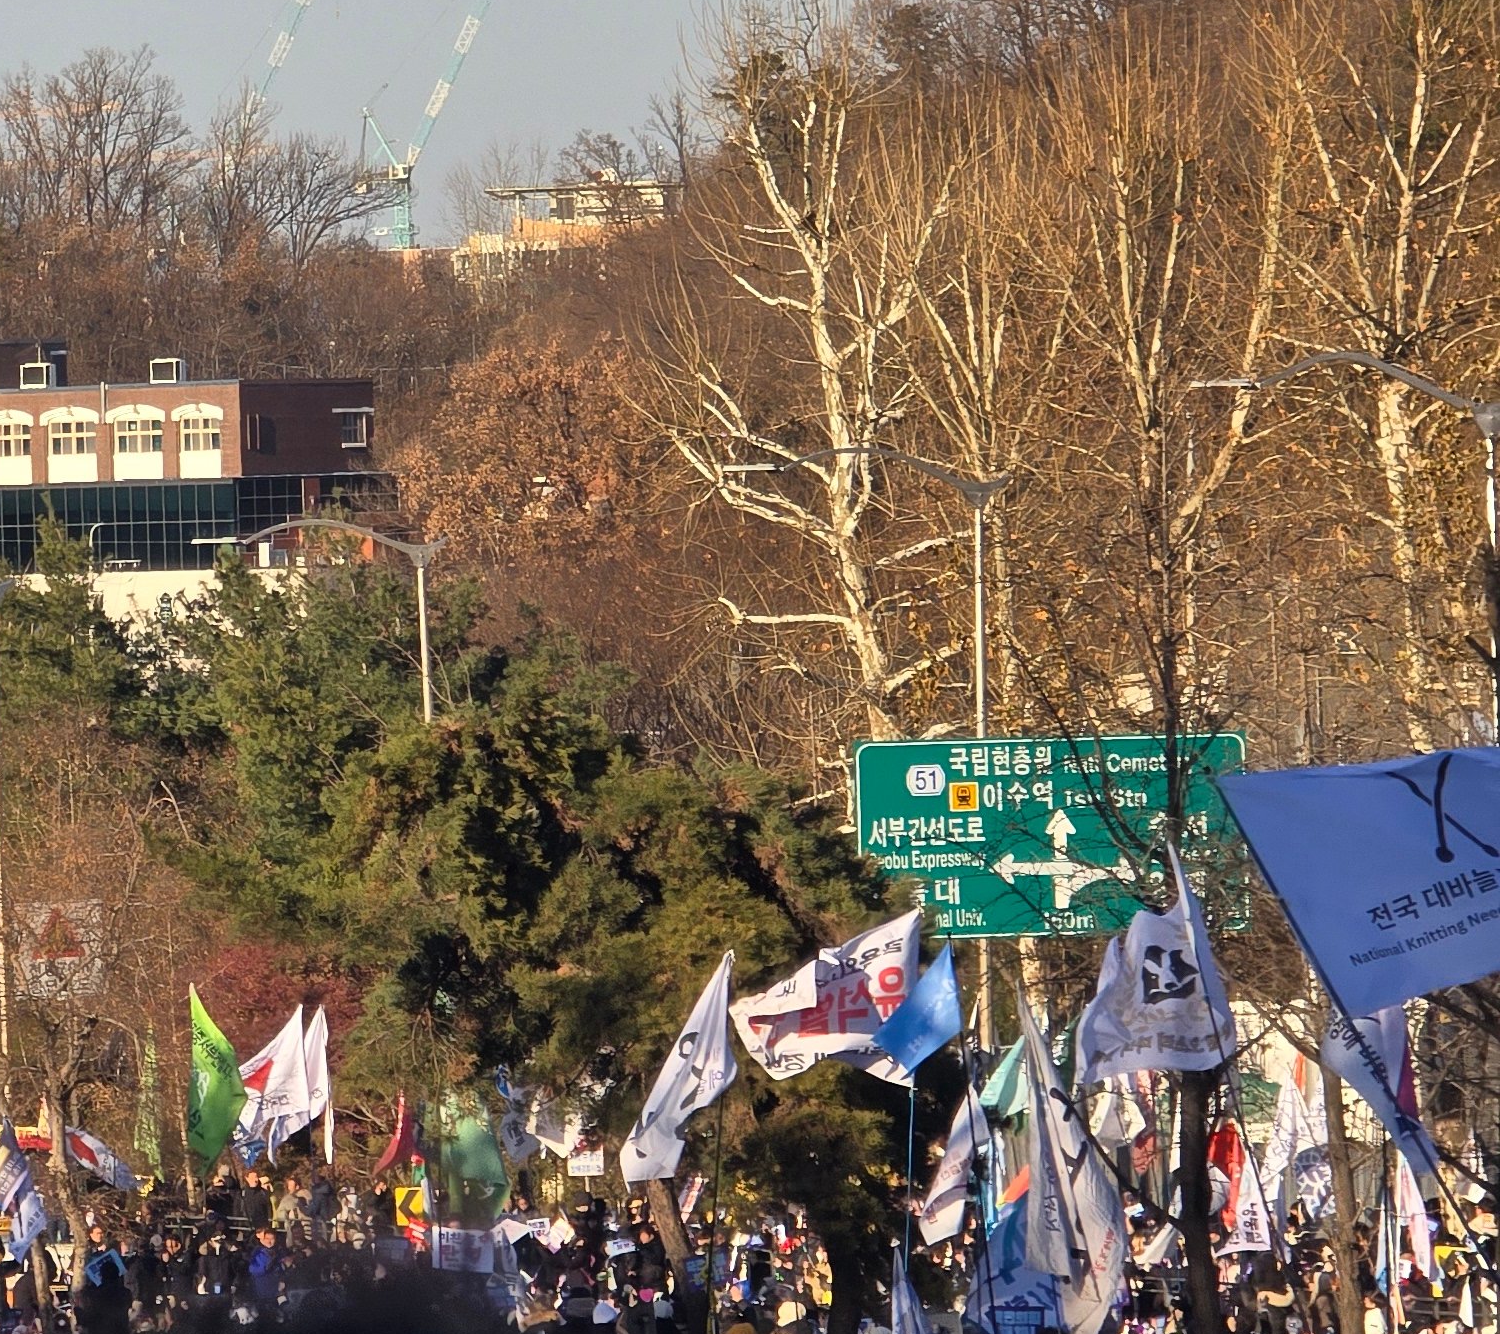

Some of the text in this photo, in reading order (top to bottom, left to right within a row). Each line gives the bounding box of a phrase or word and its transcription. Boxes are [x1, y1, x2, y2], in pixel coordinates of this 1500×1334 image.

[949, 746, 1052, 776] 국립현충원
[915, 770, 938, 791] 51
[983, 781, 1054, 812] 이수역
[868, 815, 986, 848] 서부간선도로
[1366, 869, 1500, 931] 전국 대바늘
[1349, 907, 1500, 967] National Knitting Nee
